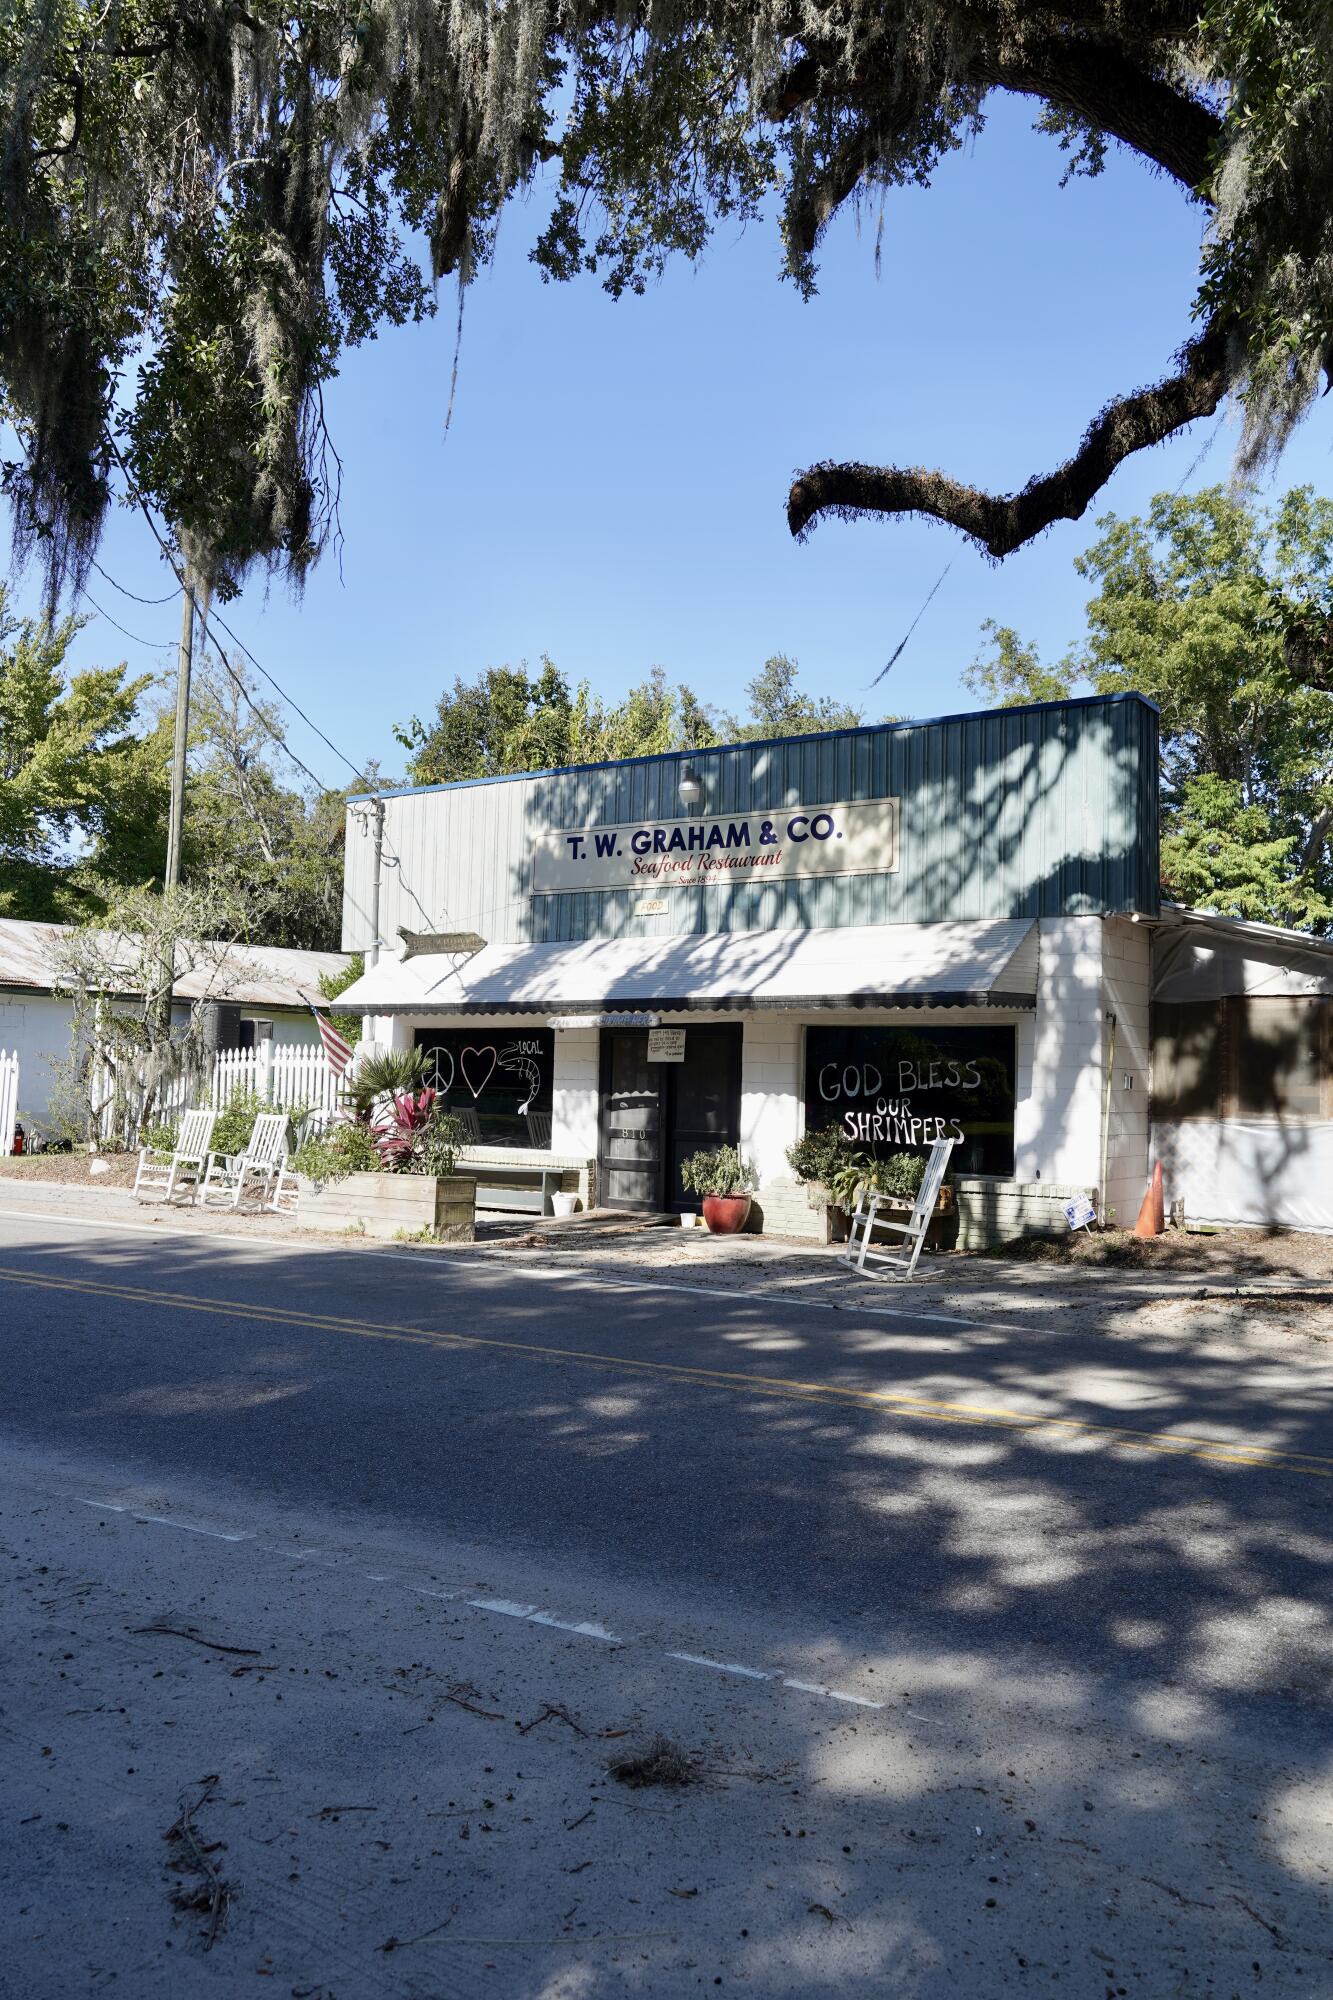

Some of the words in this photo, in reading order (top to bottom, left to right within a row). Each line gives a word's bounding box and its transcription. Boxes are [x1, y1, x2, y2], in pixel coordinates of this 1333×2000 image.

[567, 836, 587, 860] T.
[594, 833, 623, 857] W.
[631, 821, 750, 855] GRAHAM
[759, 820, 779, 845] &
[786, 813, 843, 843] CO.
[631, 853, 693, 878] Seafood
[697, 849, 783, 871] Restaurant
[678, 875, 697, 884] Since
[640, 901, 664, 913] FOOD
[518, 1040, 544, 1055] LOCAL
[819, 1062, 882, 1101] GOD
[898, 1060, 982, 1093] BLESS
[876, 1097, 912, 1117] OUR
[843, 1111, 965, 1145] SHRIMPERS
